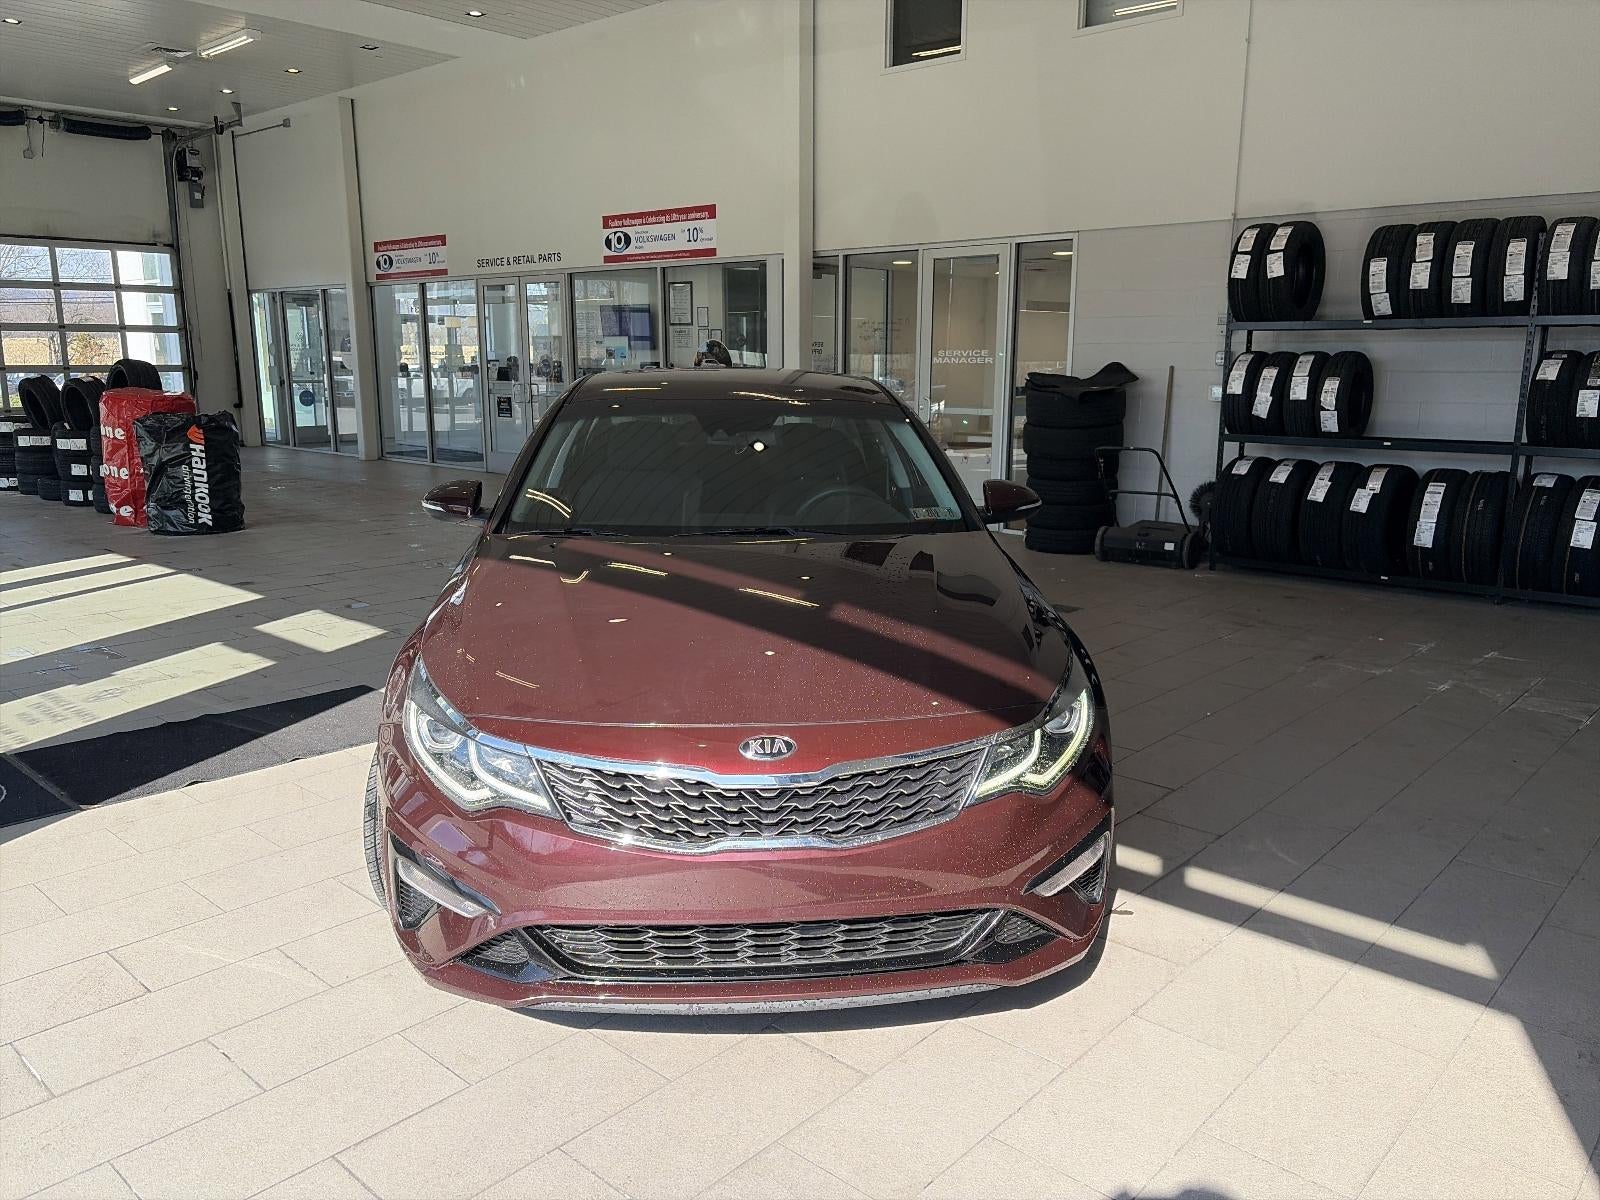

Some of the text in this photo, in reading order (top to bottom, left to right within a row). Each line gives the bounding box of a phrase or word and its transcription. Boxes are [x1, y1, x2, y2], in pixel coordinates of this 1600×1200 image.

[608, 231, 626, 252] 10
[634, 233, 676, 244] VOLKSWAGEN
[476, 251, 562, 269] SERVICE & RETAIL PARTS
[933, 356, 994, 364] MANAGER
[937, 349, 990, 357] SERVICE
[182, 465, 193, 494] driving
[189, 443, 213, 527] Hankook
[748, 738, 788, 754] KIA
